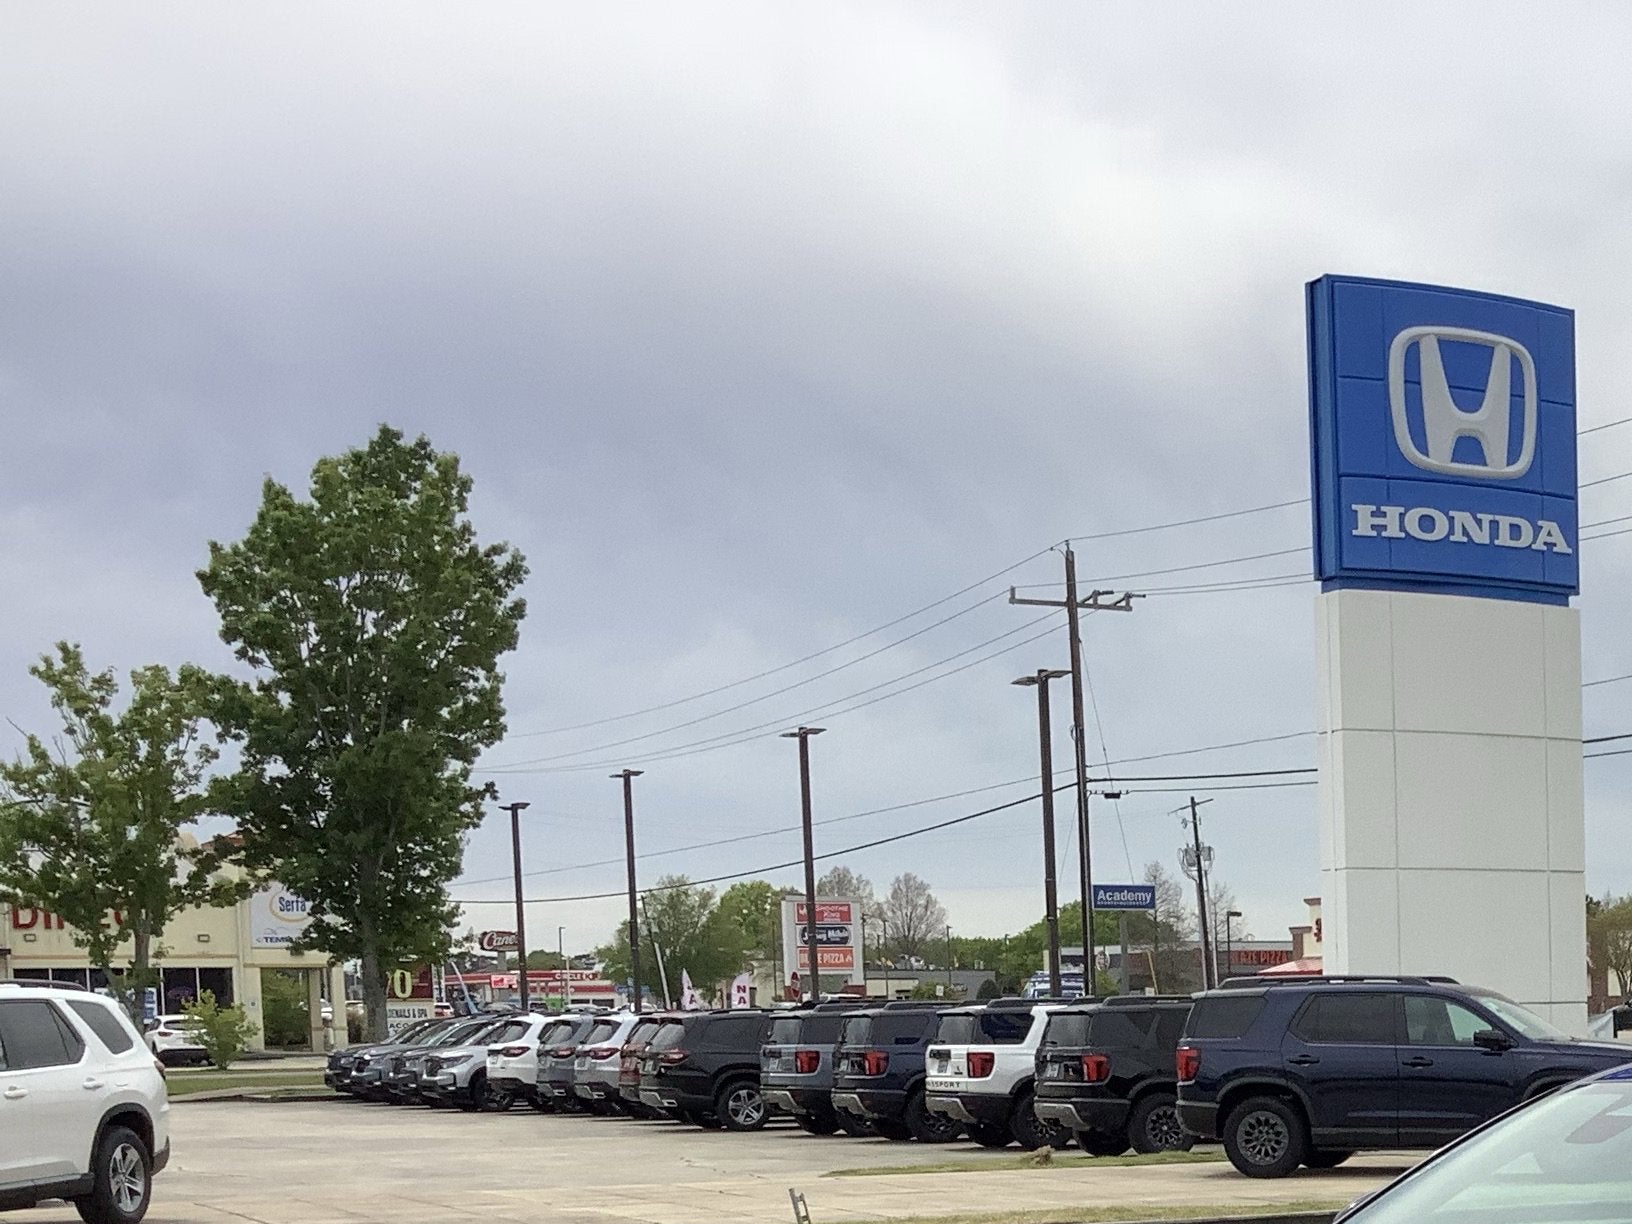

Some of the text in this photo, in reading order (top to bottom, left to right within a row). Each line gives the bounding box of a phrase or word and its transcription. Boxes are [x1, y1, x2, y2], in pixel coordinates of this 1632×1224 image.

[1351, 503, 1572, 554] HONDA
[1097, 889, 1152, 904] Academy
[278, 897, 306, 912] Serta
[823, 953, 845, 963] PIZZA
